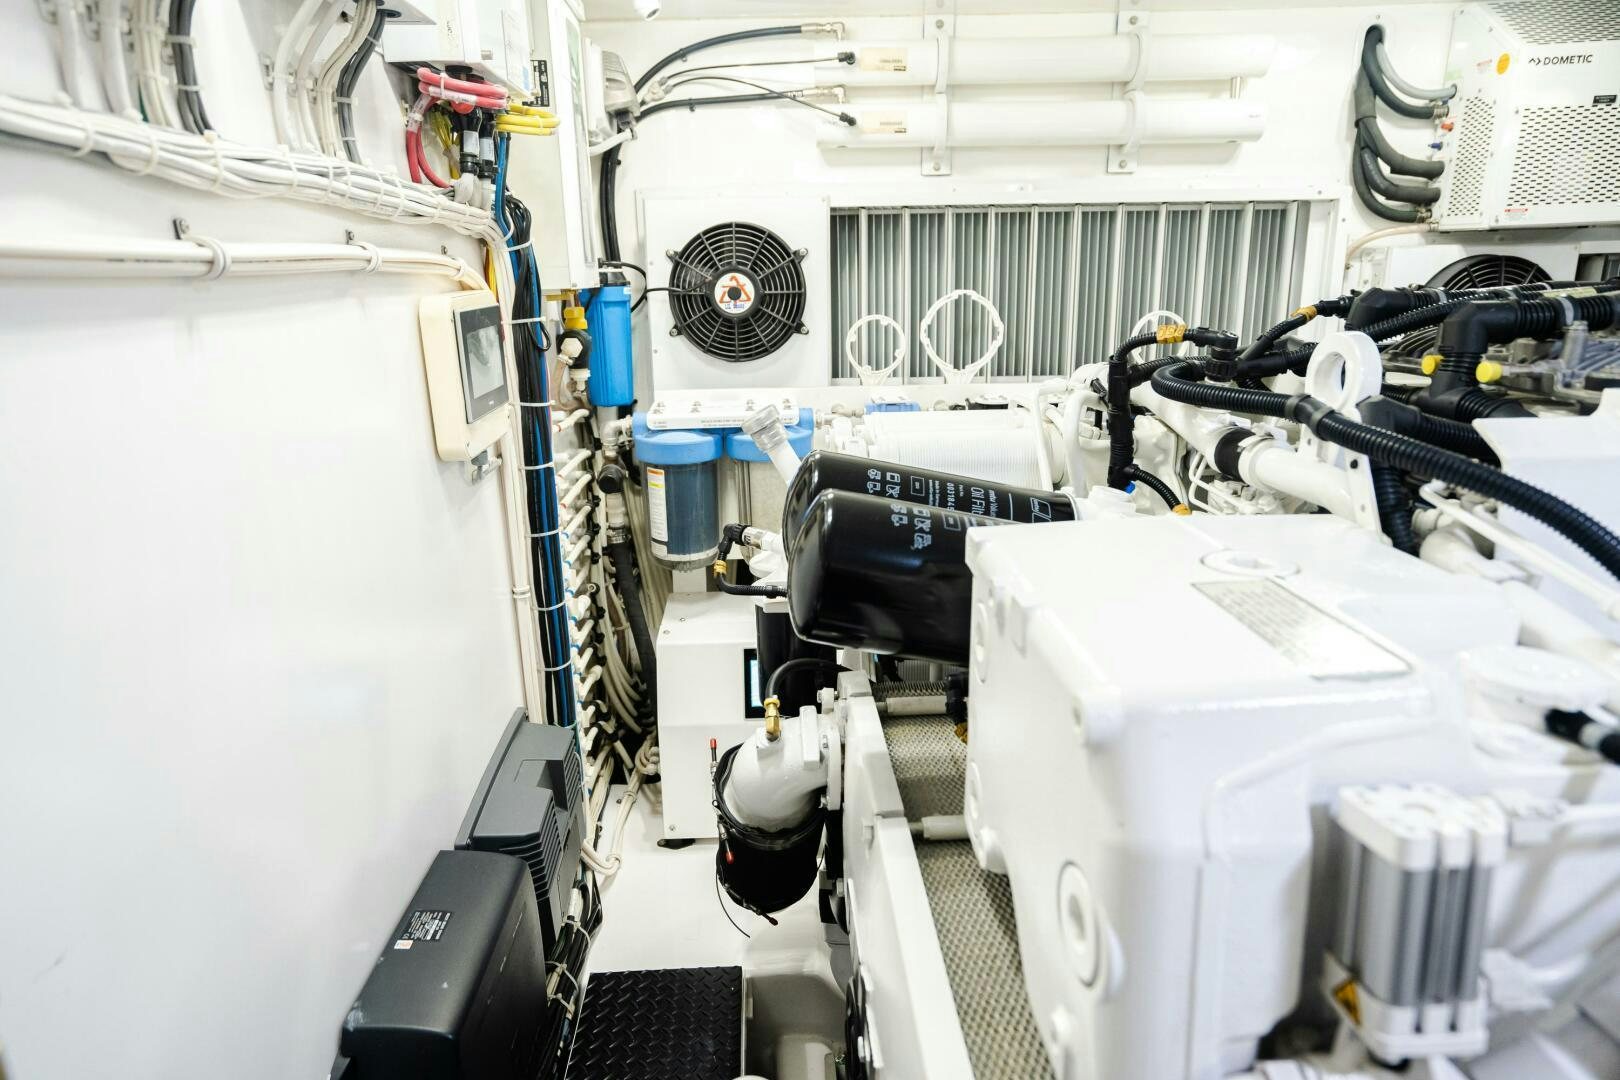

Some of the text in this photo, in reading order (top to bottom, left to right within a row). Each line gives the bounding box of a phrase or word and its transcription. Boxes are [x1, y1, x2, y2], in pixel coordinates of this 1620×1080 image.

[1543, 54, 1593, 66] DOMETIC
[970, 486, 985, 499] Oil
[971, 499, 986, 516] Filt
